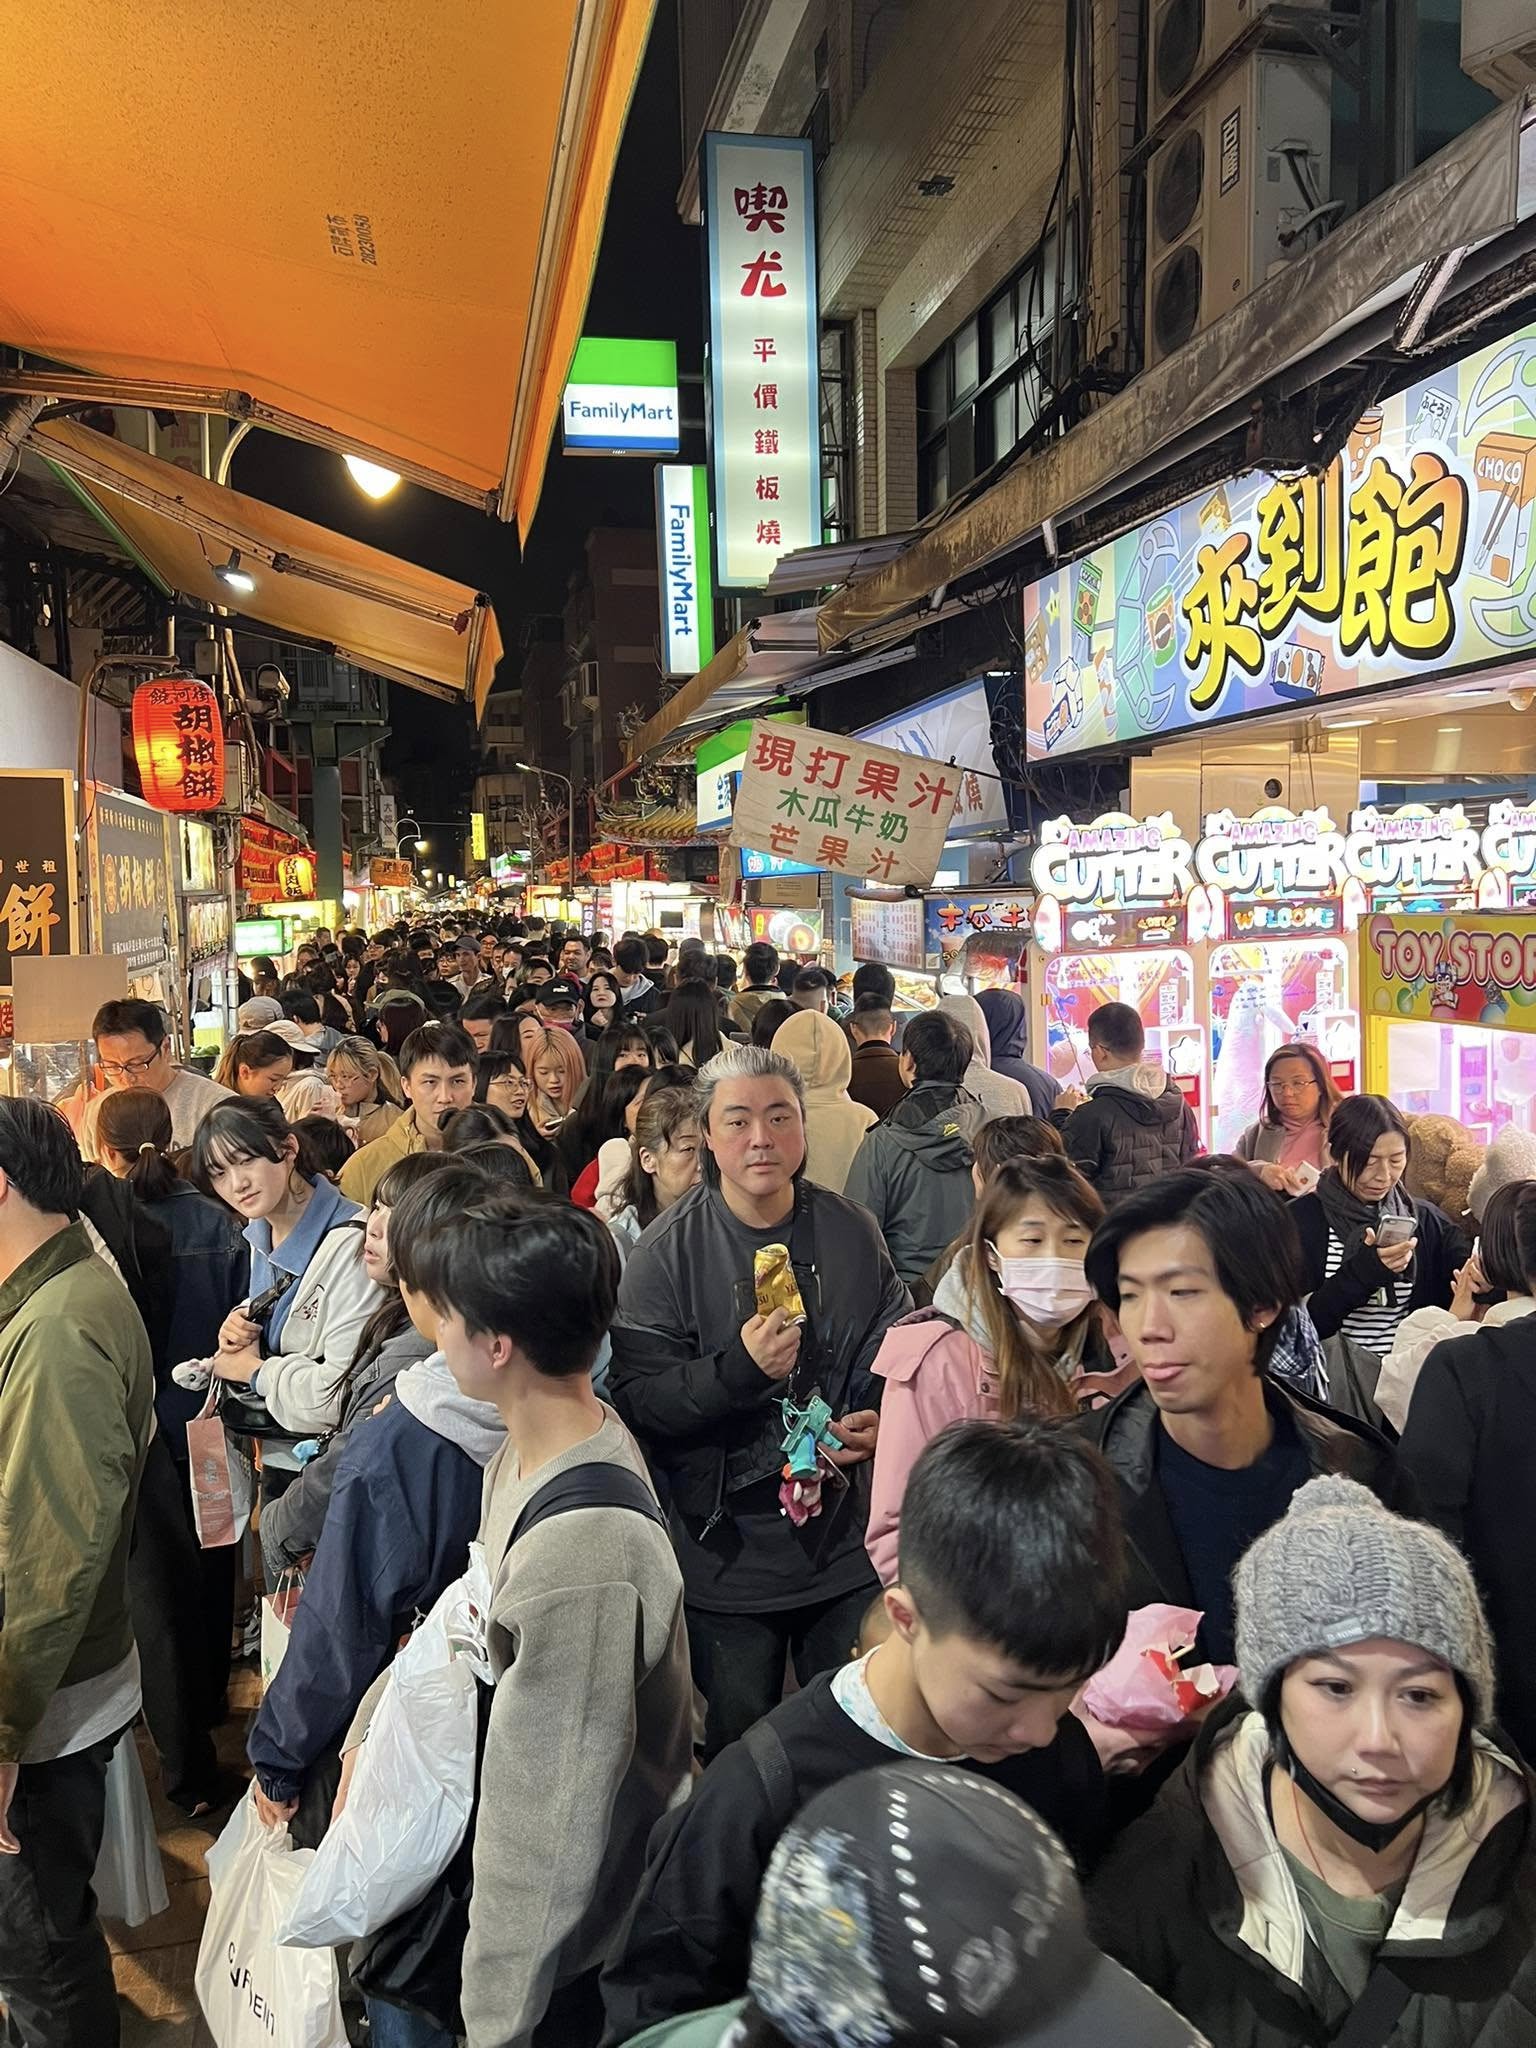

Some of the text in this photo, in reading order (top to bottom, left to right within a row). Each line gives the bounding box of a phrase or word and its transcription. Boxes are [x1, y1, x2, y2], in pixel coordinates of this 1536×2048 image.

[570, 401, 674, 423] FamilyMart
[753, 338, 781, 546] 平價鐵板燒
[1477, 456, 1522, 485] CHOCO
[670, 504, 694, 636] FamilyMart
[173, 703, 219, 800] 胡椒餅
[752, 733, 953, 814] 現打果汁
[776, 786, 909, 844] 木瓜牛奶
[1069, 827, 1161, 852] AMAZING
[1231, 820, 1318, 844] AMAZING
[1374, 817, 1452, 840] AMAZING
[0, 859, 57, 874] 世祖
[769, 822, 900, 879] 芒果汁
[1031, 837, 1194, 904] CUTTER
[1196, 831, 1350, 895] CUTTER
[1345, 828, 1483, 887] CUTTER
[937, 903, 1036, 932] 木瓜牛
[1376, 930, 1444, 982] TOY
